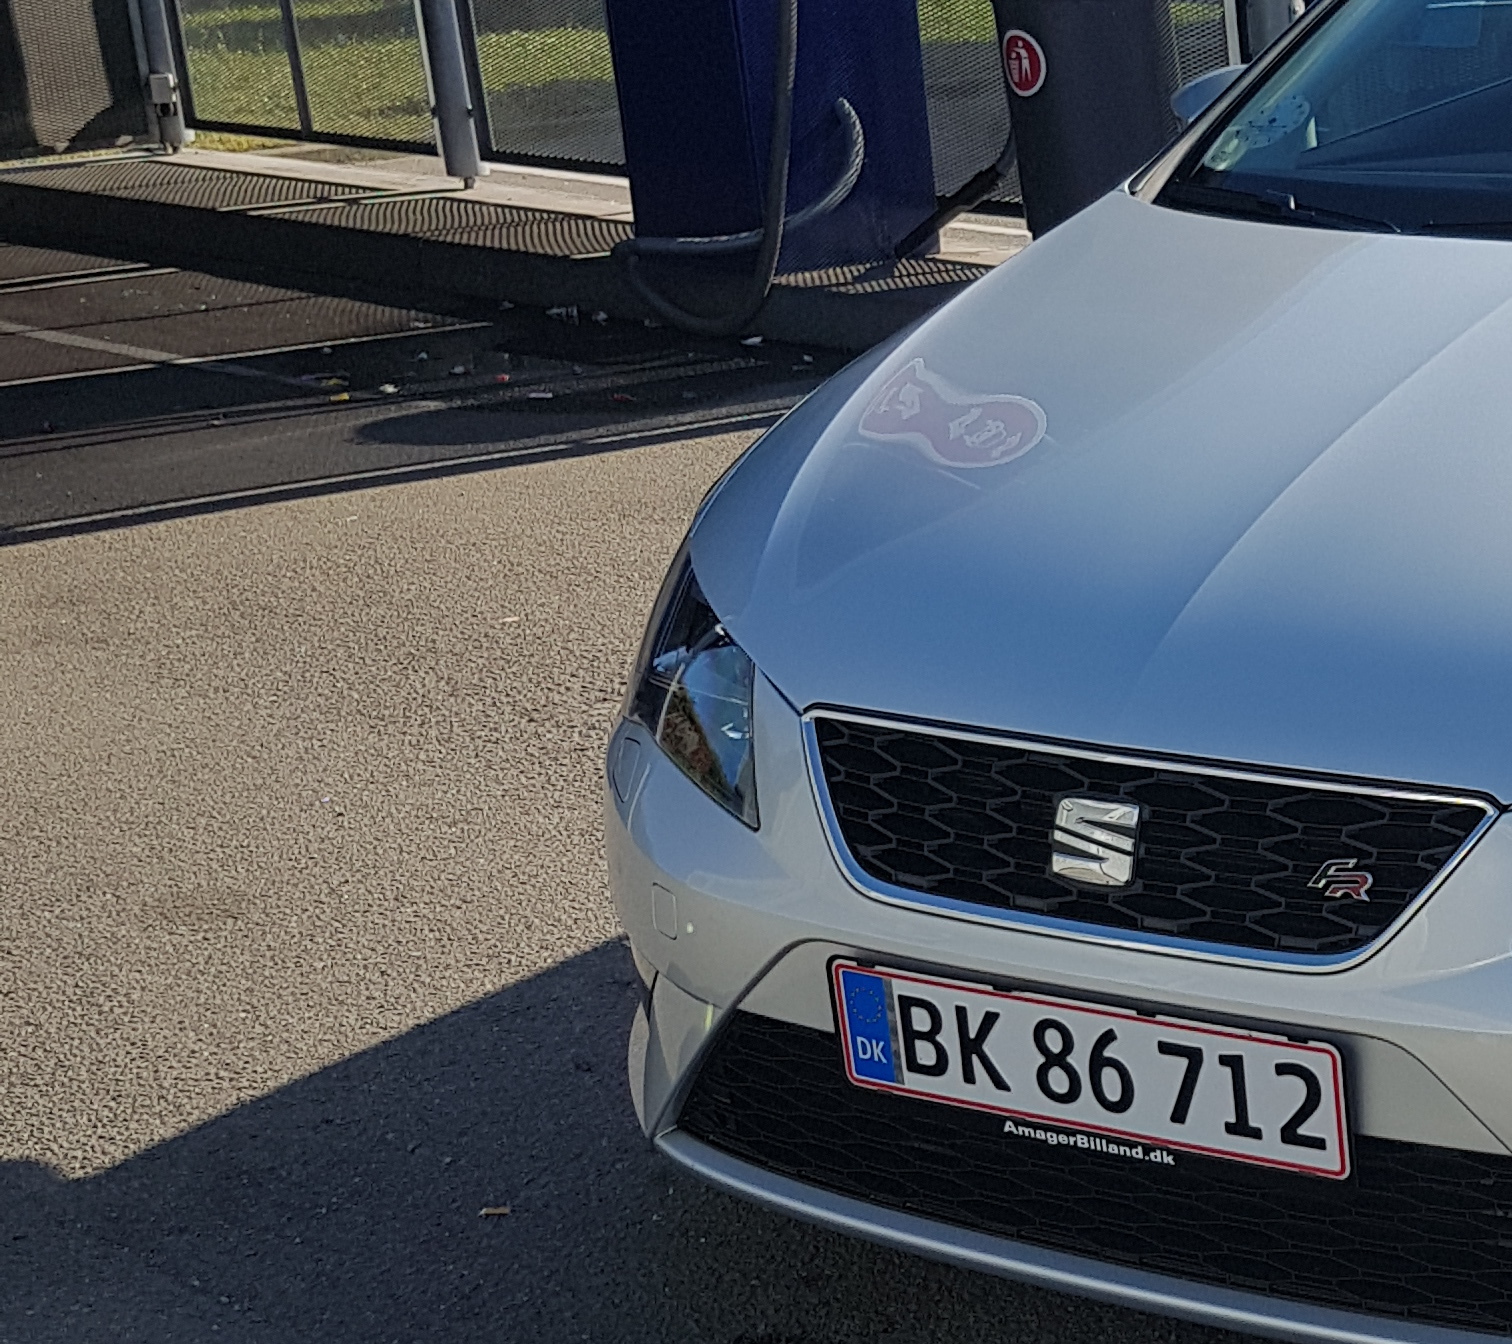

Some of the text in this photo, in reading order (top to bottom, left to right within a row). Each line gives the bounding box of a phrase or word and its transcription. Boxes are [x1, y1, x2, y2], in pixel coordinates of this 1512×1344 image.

[857, 1035, 888, 1065] DK
[897, 993, 1328, 1151] BK 86 712
[1003, 1120, 1176, 1166] AmagerBilland.dk
